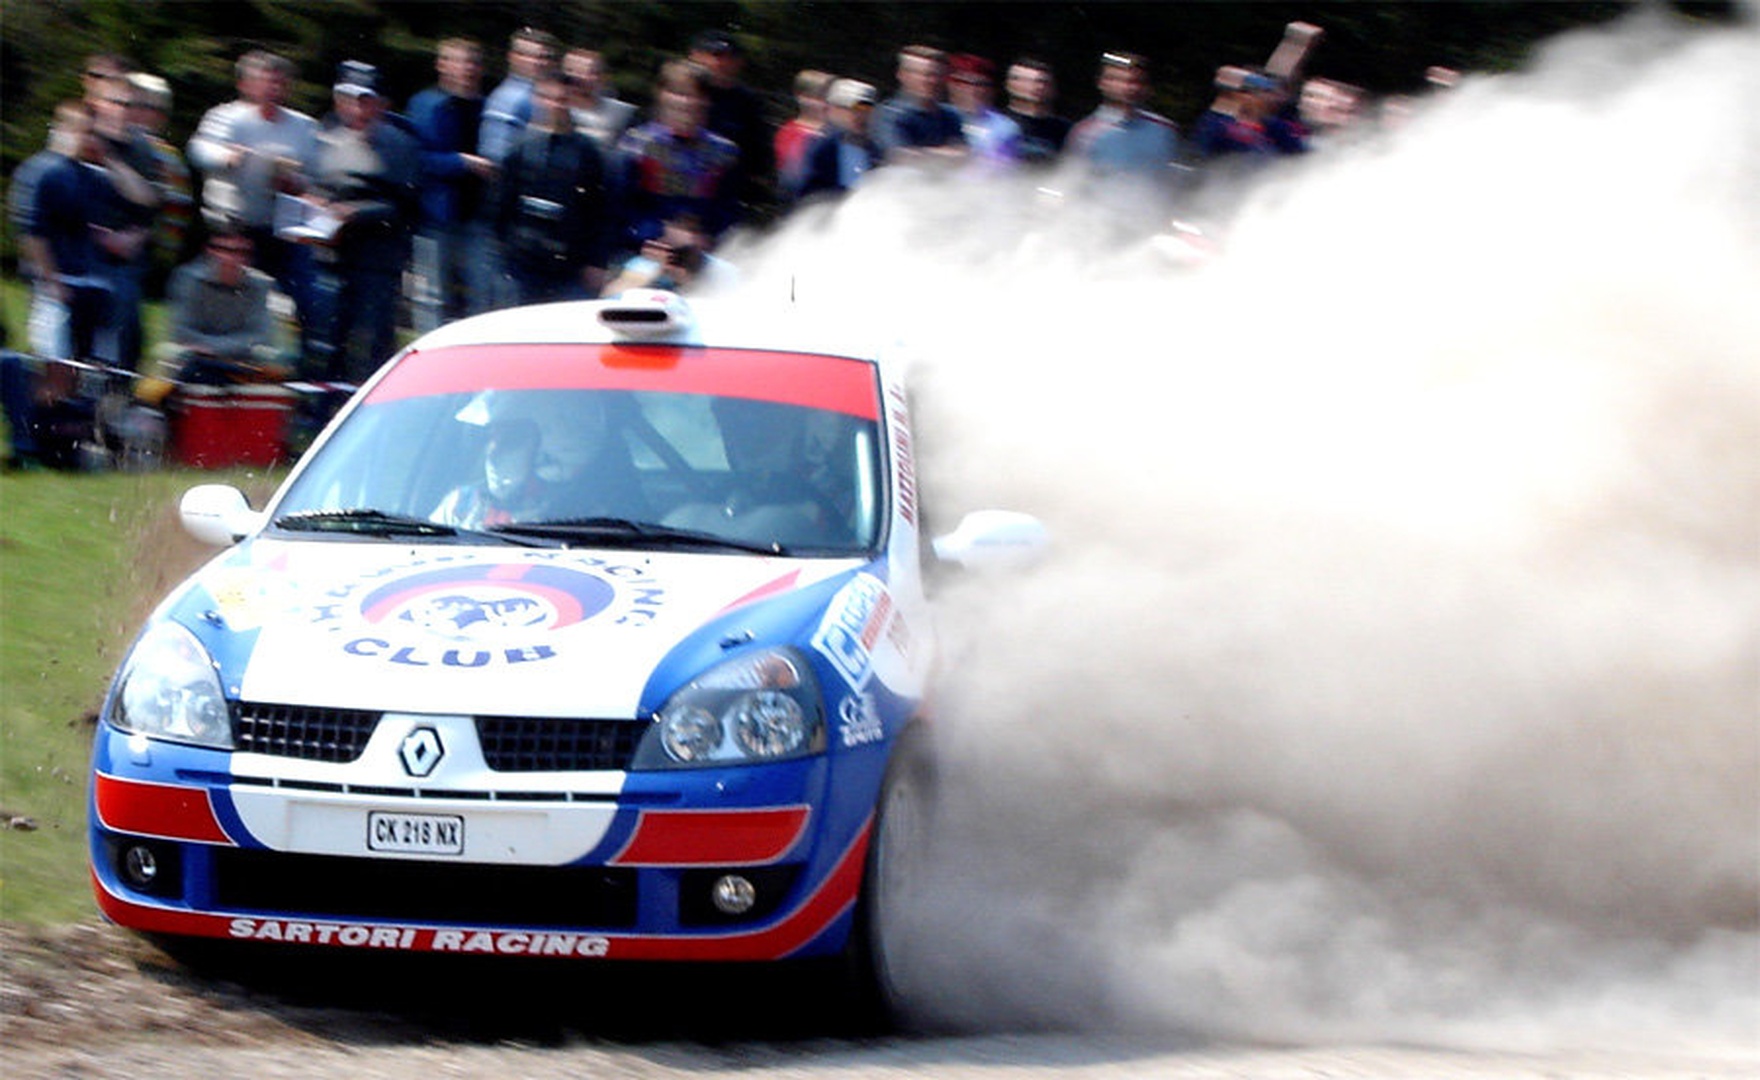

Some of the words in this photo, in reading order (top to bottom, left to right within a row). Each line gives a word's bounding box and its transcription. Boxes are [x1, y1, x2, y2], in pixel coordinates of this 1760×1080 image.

[342, 637, 558, 668] CLUB
[376, 818, 398, 842] CK
[436, 821, 458, 845] NX
[228, 918, 415, 949] SARTORI
[431, 931, 610, 957] RACING
